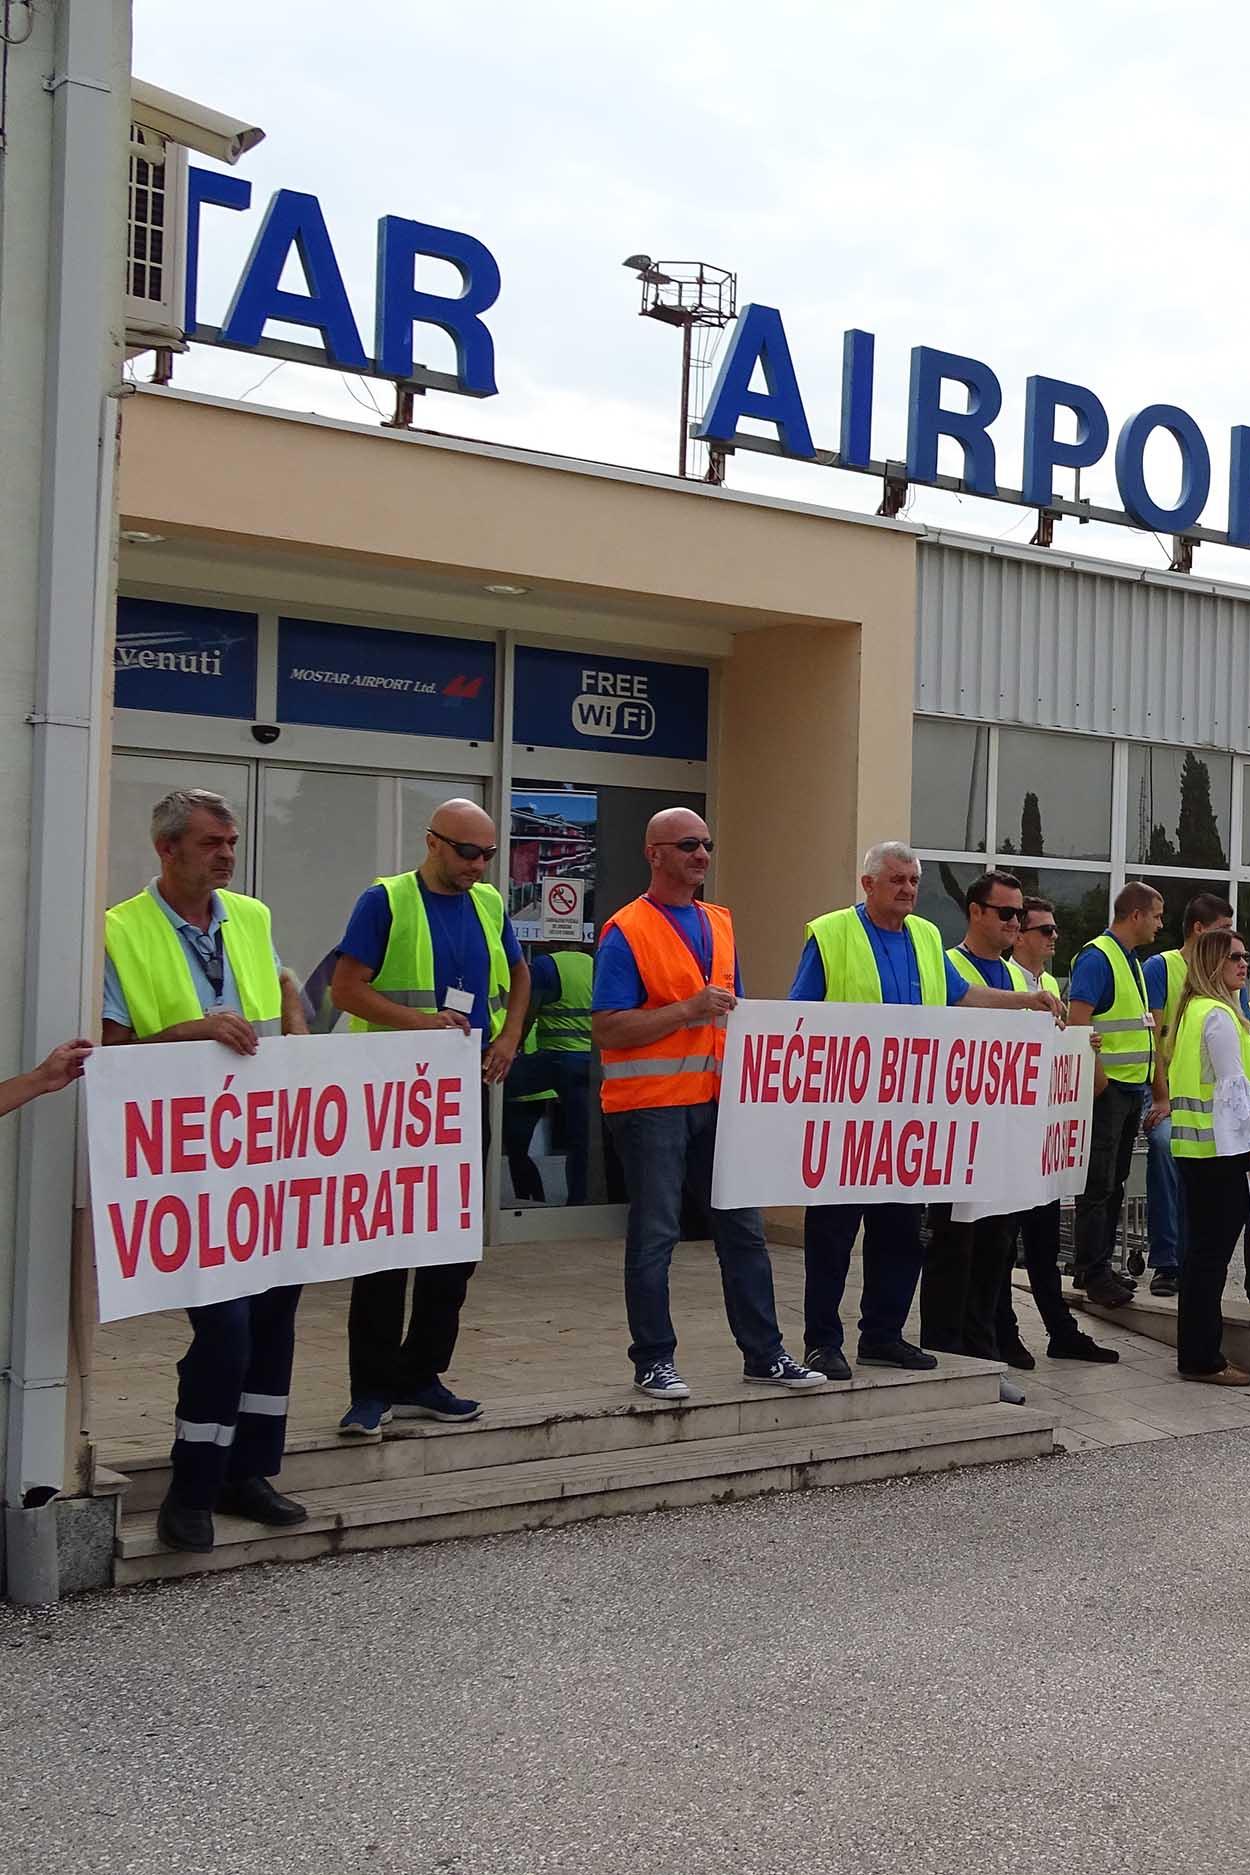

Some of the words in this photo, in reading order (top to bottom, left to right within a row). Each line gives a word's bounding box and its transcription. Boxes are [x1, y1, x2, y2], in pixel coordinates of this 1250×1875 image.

[113, 647, 222, 676] venuti
[290, 668, 349, 685] MOSTAR
[351, 674, 412, 692] AIRPORT
[413, 681, 436, 693] Ltd.
[581, 670, 648, 698] FREE
[739, 1018, 871, 1105] NEĆEMO
[878, 1037, 940, 1105] BITI
[945, 1039, 1042, 1106] GUSKE
[124, 1074, 348, 1178] NEĆEMO
[364, 1062, 462, 1151] VIŠE
[801, 1120, 831, 1189] U
[839, 1120, 958, 1187] MAGLI
[107, 1164, 438, 1279] VOLONTIRATI
